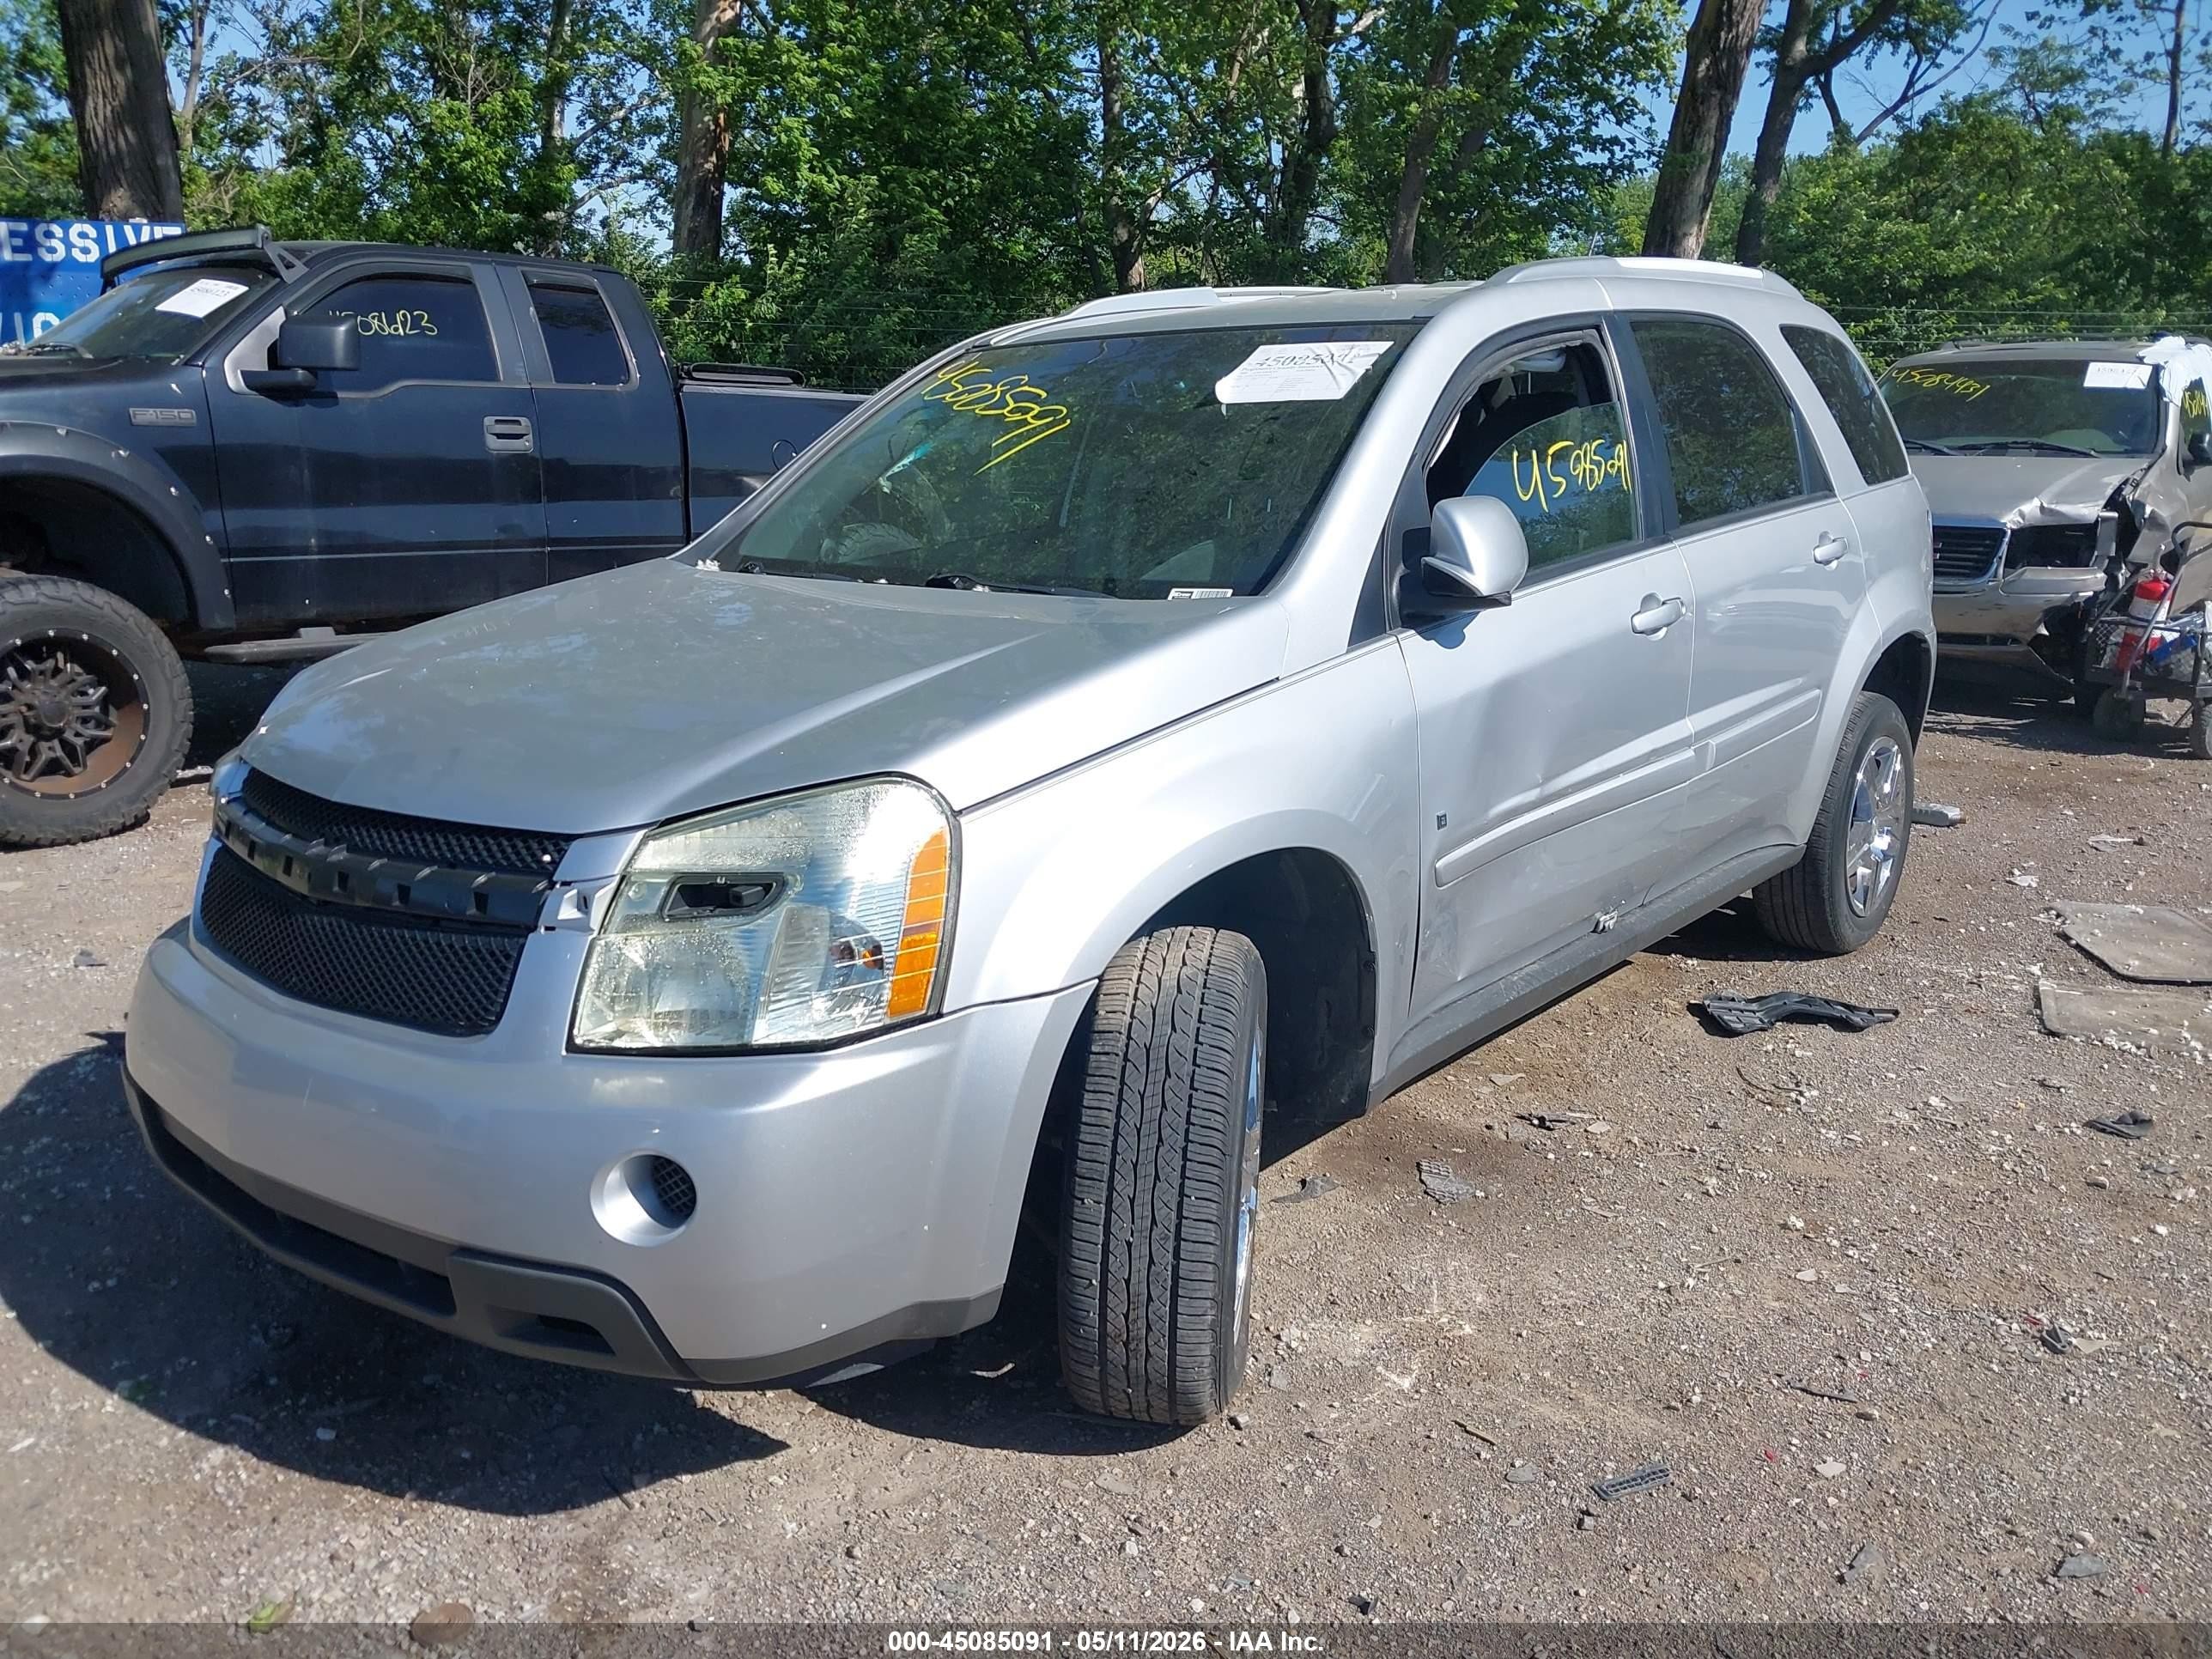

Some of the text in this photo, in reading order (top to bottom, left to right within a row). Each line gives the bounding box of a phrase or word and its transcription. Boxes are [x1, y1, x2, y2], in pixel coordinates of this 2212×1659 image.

[0, 221, 182, 263] ESSIV
[1892, 368, 1991, 402] 45084431
[131, 409, 194, 421] F-150
